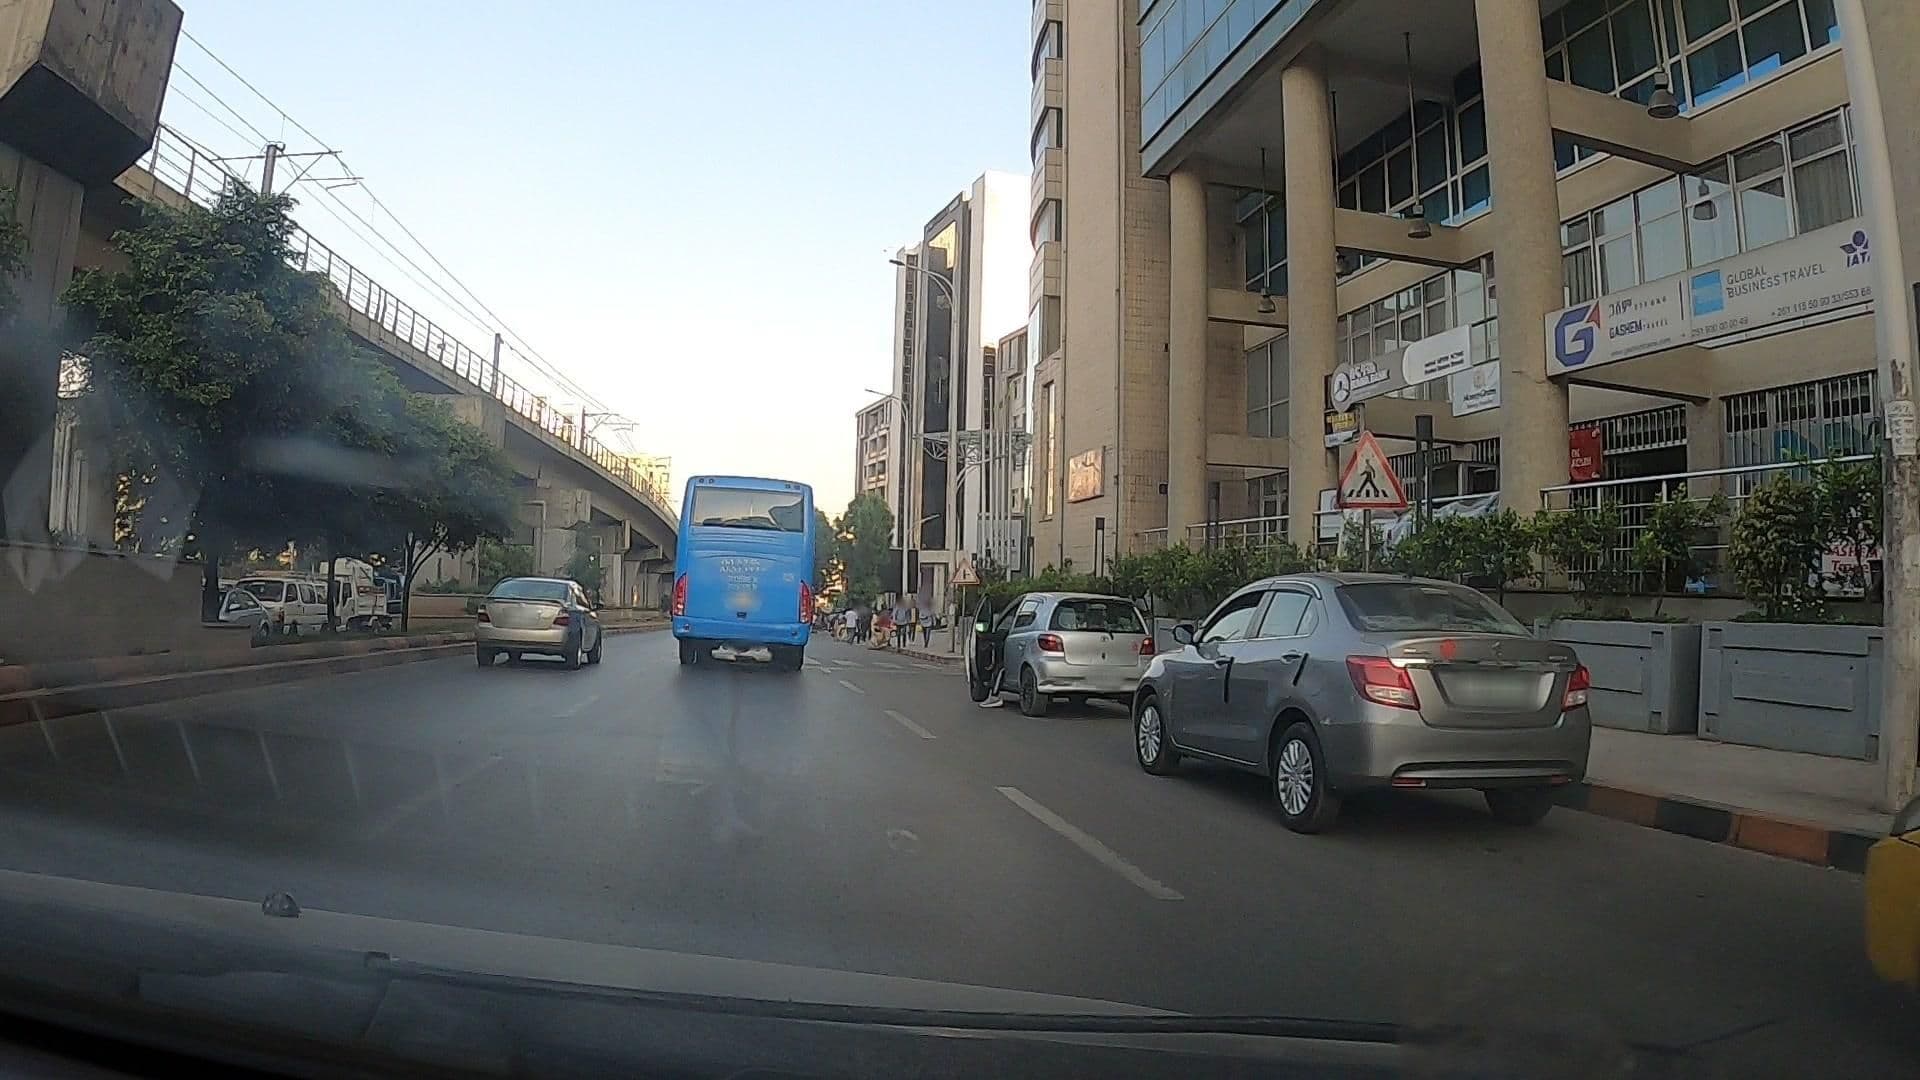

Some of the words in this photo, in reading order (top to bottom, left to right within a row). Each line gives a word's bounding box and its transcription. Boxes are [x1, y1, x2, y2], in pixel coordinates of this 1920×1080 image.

[1726, 265, 1767, 285] GLOBAL
[1726, 275, 1781, 298] BUSINESS
[1781, 264, 1825, 283] TRAVEL
[1609, 320, 1642, 339] GASHEM
